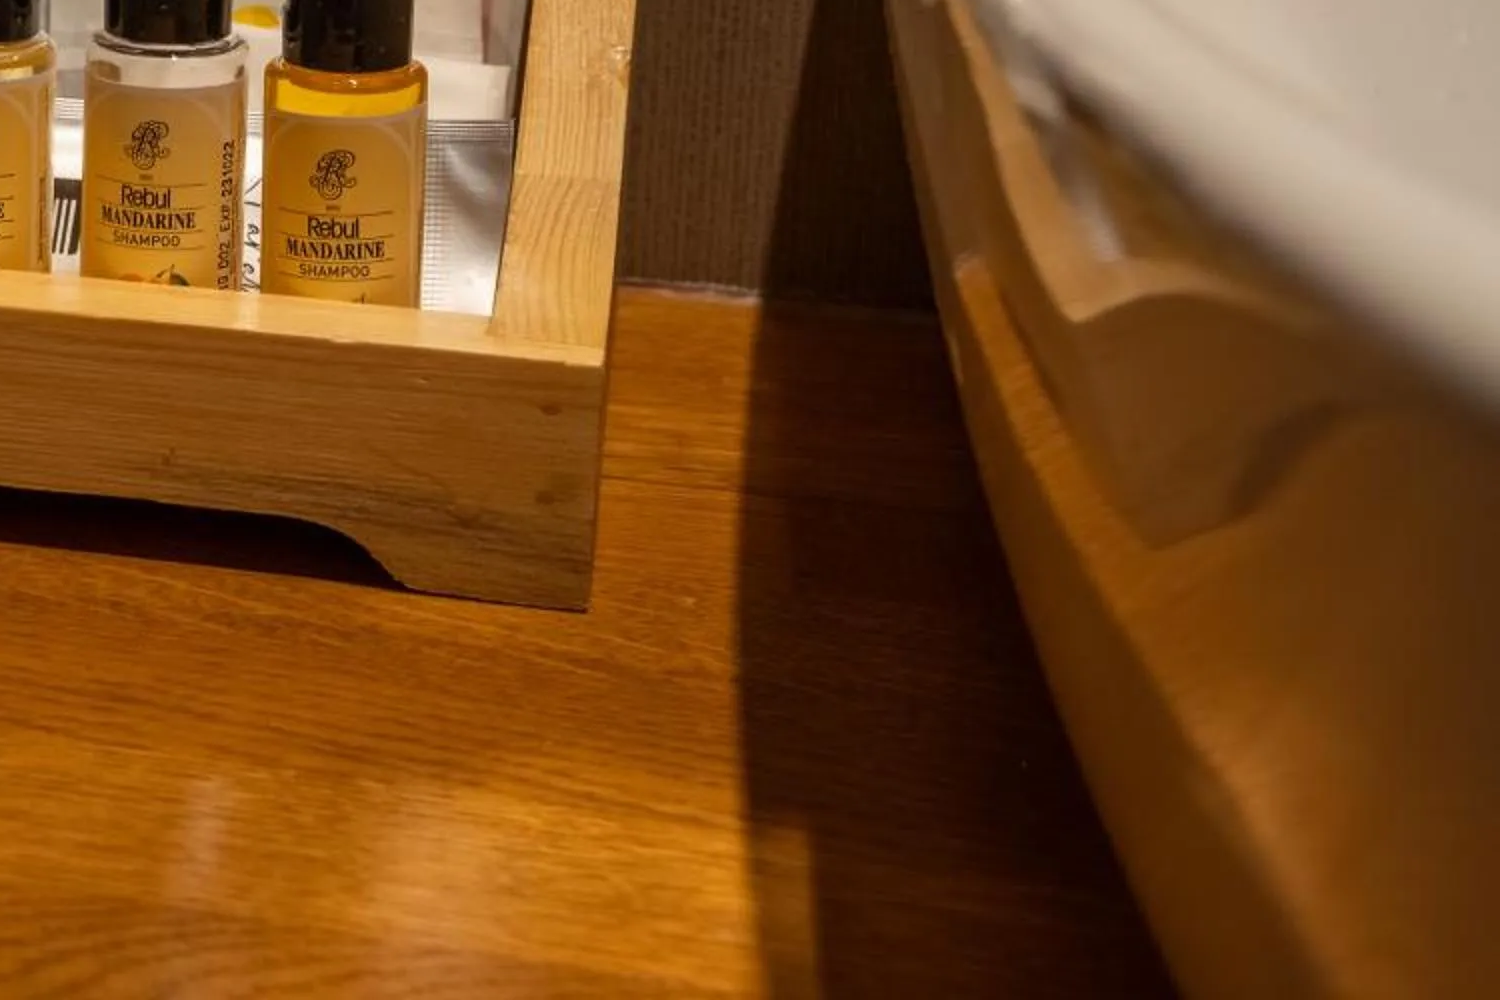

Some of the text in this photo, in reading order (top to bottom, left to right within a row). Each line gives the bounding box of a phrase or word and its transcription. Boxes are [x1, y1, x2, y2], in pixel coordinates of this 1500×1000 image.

[121, 184, 171, 209] Rebul
[102, 205, 197, 229] MANDARINE
[220, 205, 231, 233] EXP
[307, 216, 361, 240] Rebul
[113, 230, 181, 247] SHAMPOO
[286, 237, 385, 261] MANDARINE
[299, 263, 371, 278] SHAMPOO
